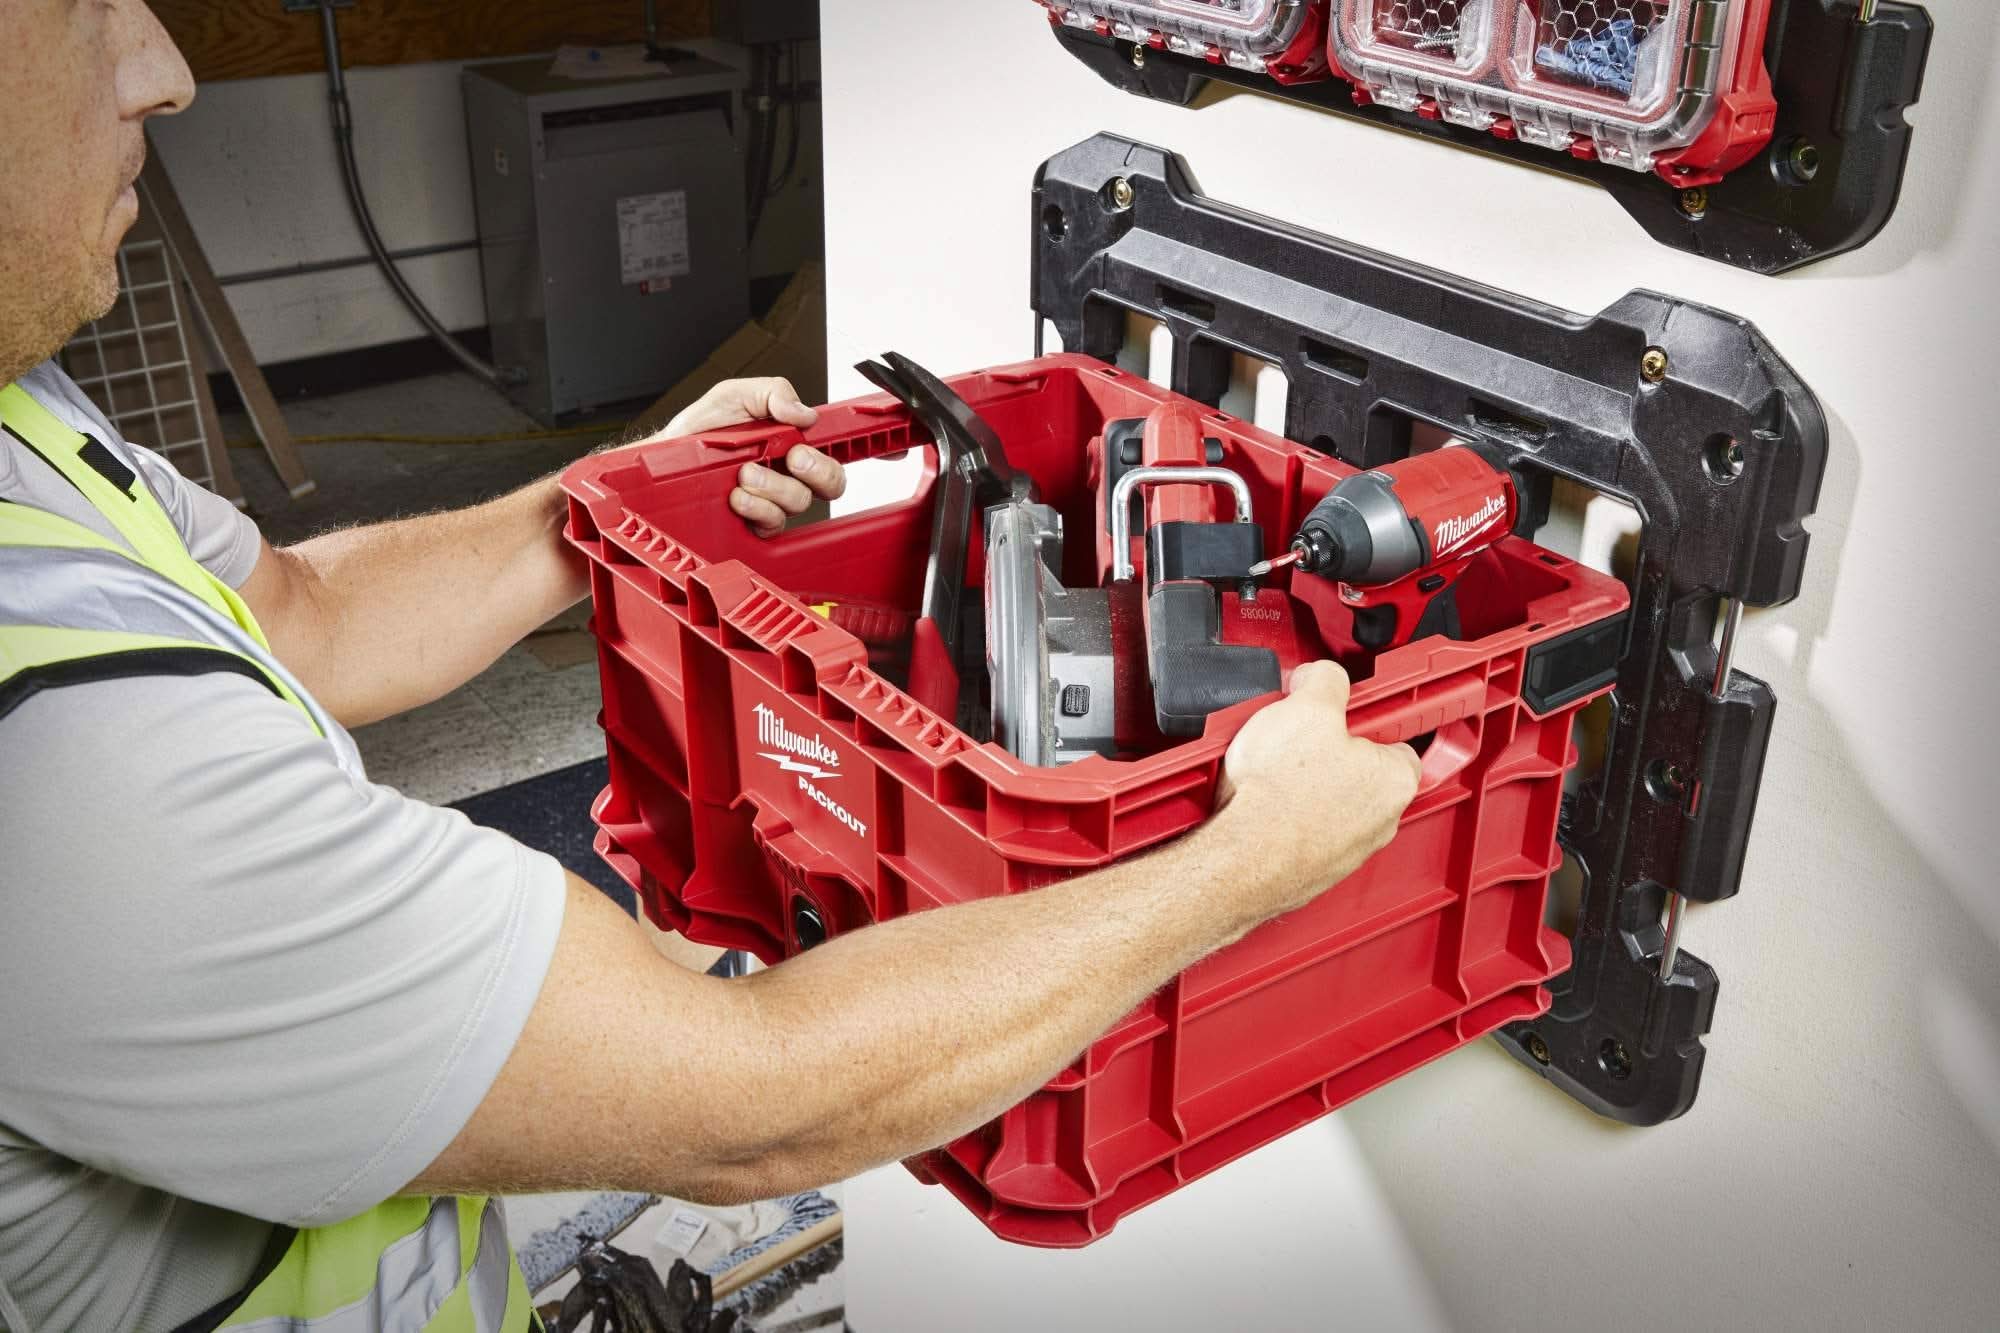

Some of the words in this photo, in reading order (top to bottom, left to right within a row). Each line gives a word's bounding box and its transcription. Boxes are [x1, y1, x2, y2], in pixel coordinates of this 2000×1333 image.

[1434, 494, 1506, 553] Milwaukee
[1240, 607, 1281, 621] 4010085
[752, 702, 840, 767] Milwaukee
[798, 775, 867, 838] PACKOUT
